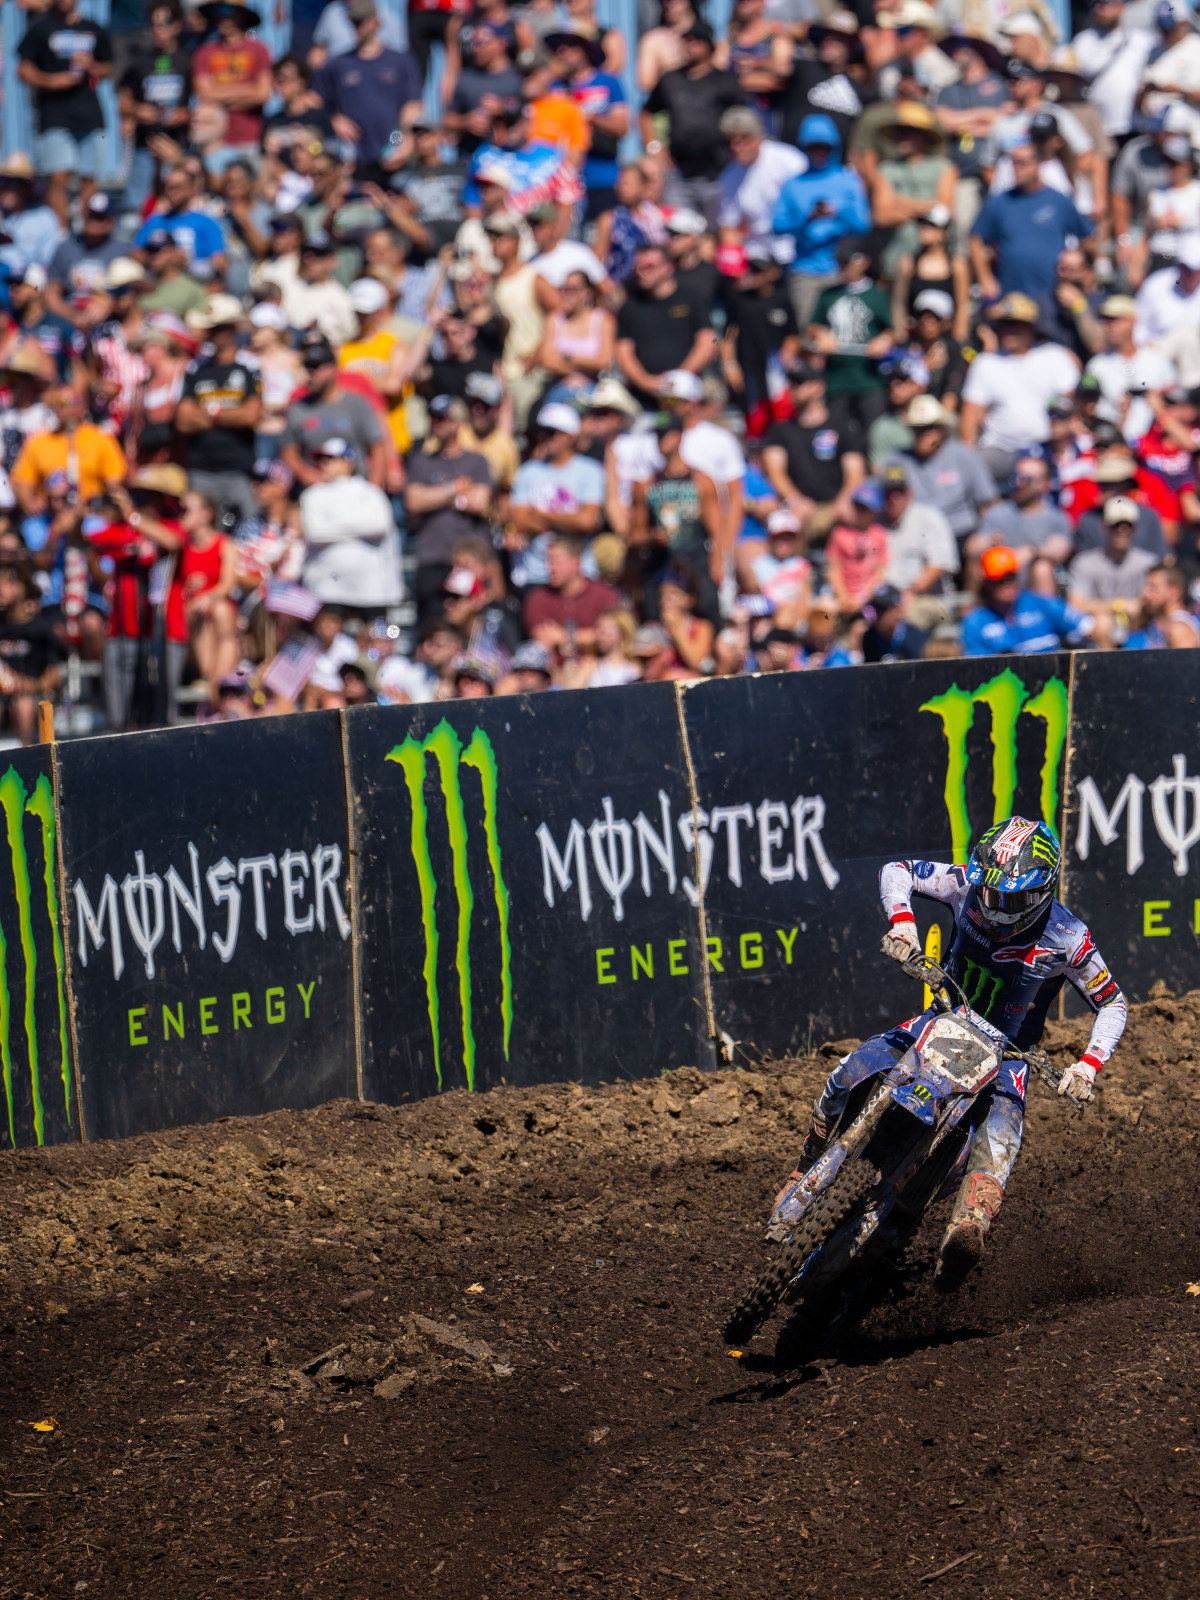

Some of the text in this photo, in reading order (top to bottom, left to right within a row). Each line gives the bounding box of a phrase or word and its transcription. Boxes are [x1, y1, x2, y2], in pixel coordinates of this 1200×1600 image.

[535, 788, 840, 921] MONSTER
[999, 842, 1017, 851] BELL
[73, 842, 351, 980] MONSTER
[965, 923, 991, 949] YAMAHA
[596, 928, 799, 985] ENERGY
[128, 981, 316, 1046] ENERGY
[927, 1037, 991, 1080] 4
